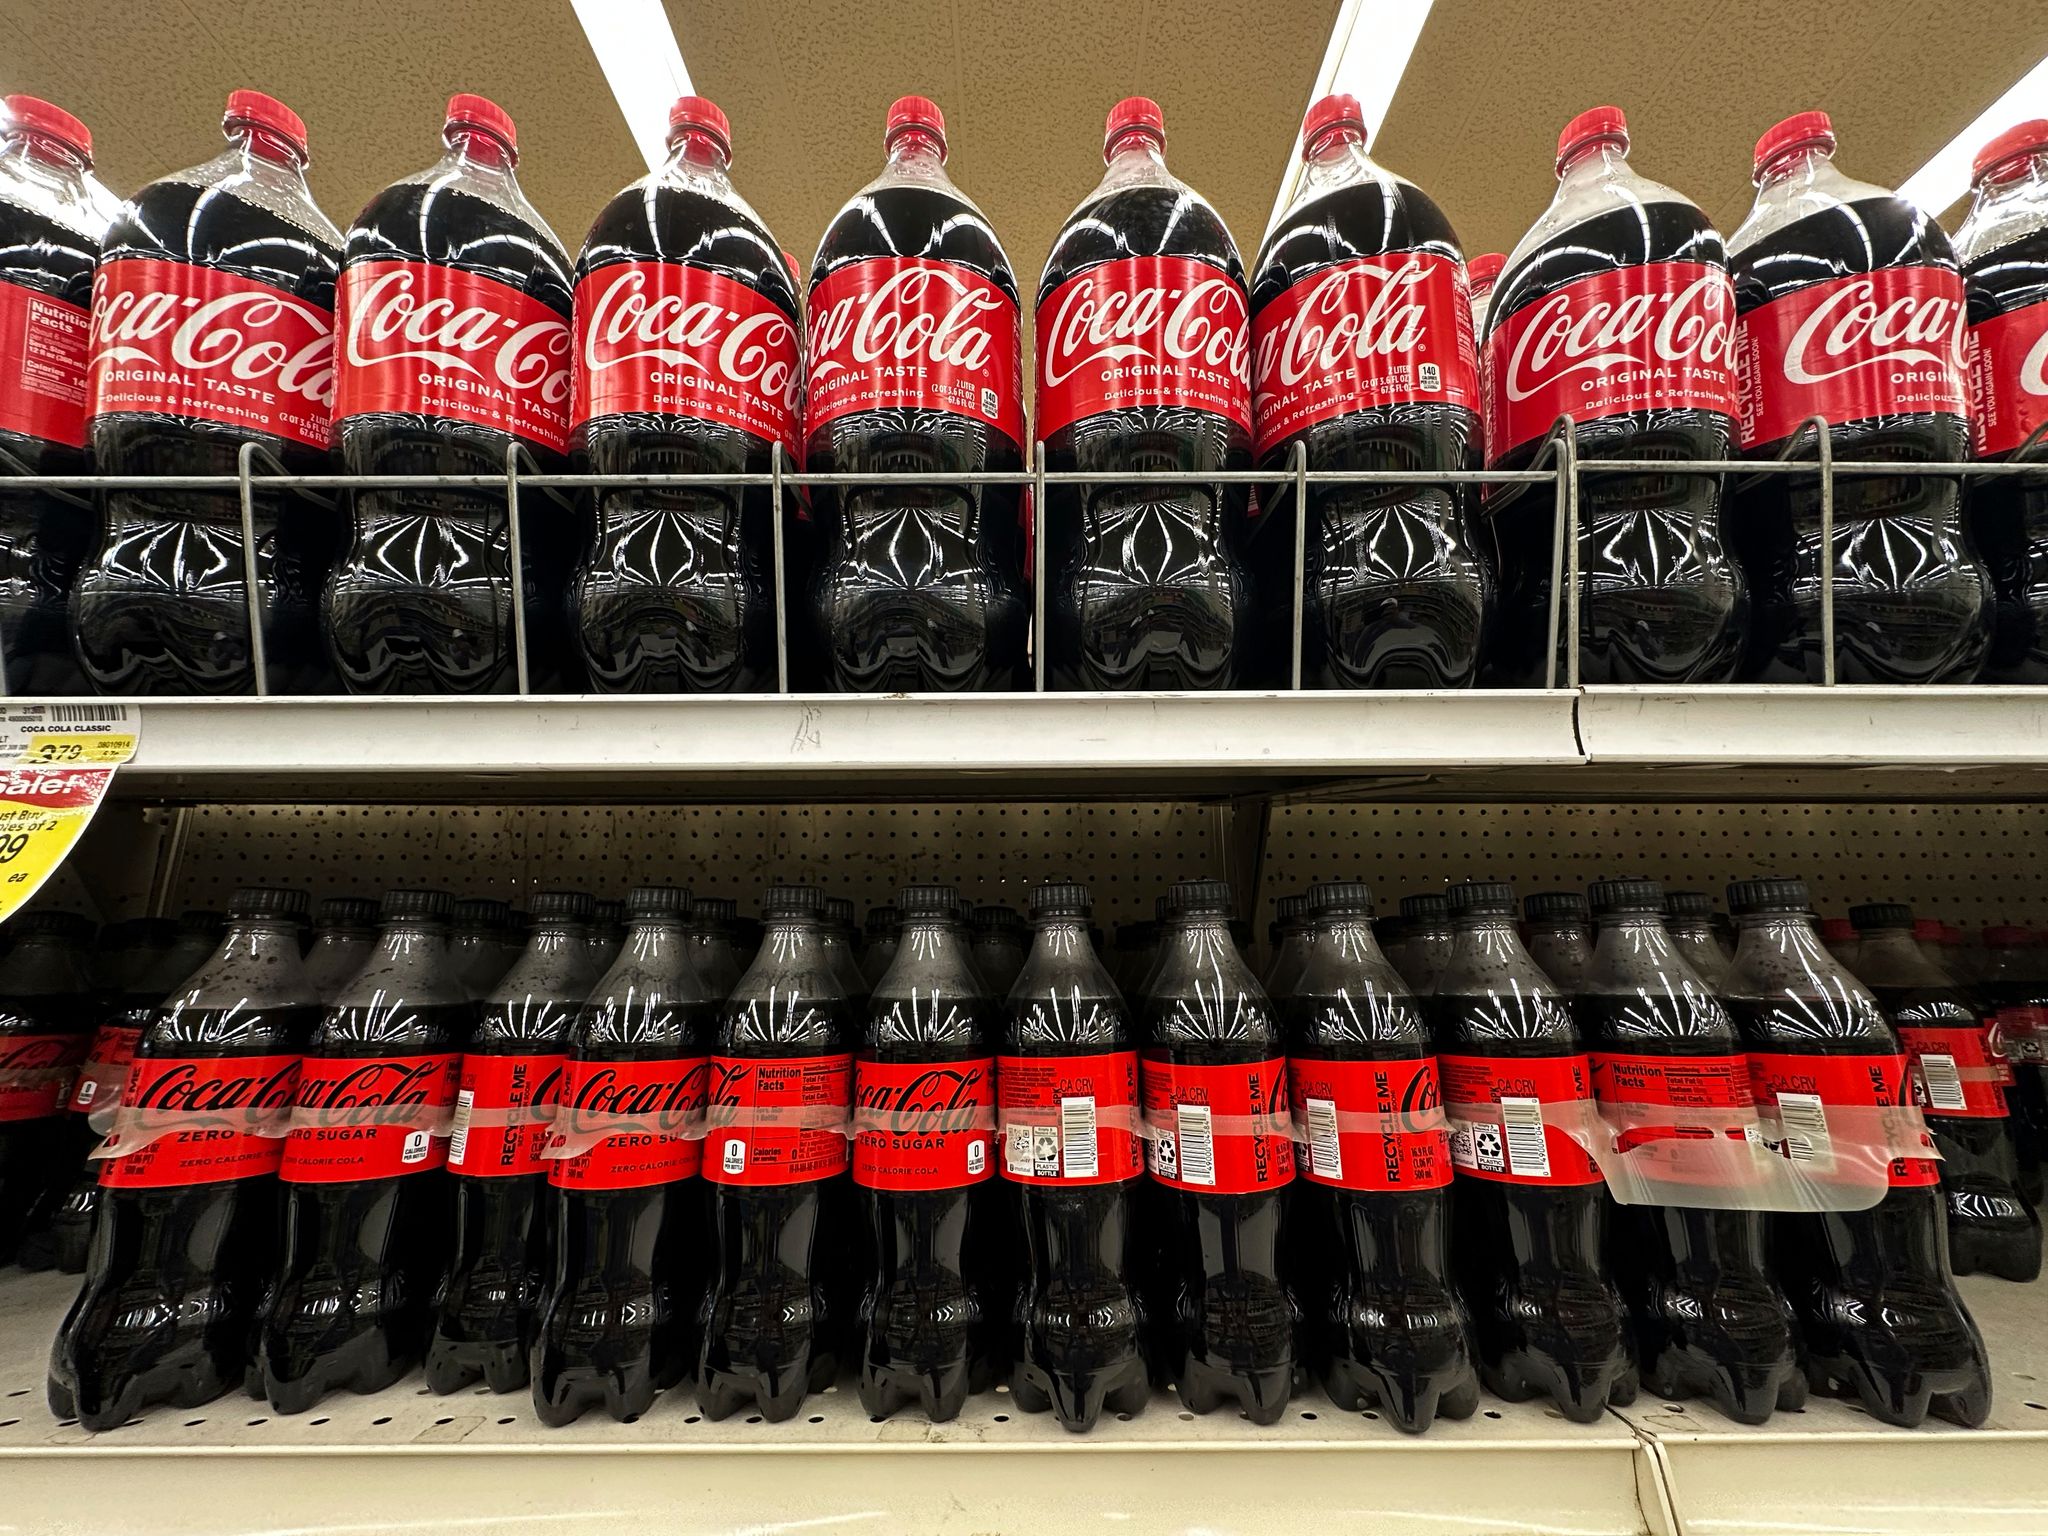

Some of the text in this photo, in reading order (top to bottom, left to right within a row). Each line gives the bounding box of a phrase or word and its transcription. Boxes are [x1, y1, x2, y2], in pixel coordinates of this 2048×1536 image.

[32, 311, 73, 333] Facts
[1253, 260, 1437, 391] a-Cola
[1506, 275, 1738, 401] Coca-Col
[1101, 365, 1230, 389] ORIGINAL TASTE
[1423, 367, 1435, 375] 140
[1581, 367, 1725, 391] ORIGINAL TASTE
[105, 370, 275, 404] ORIGINAL TASTE
[814, 367, 928, 401] ORIGINAL TASTE
[961, 381, 975, 391] LITER
[1303, 367, 1356, 394] TASTE
[1362, 376, 1398, 389] (2 3.6 FL
[1985, 373, 1994, 394] AGAIN
[650, 372, 784, 421] ORIGINAL TASTE
[932, 384, 938, 392] (2
[948, 387, 957, 396] 3.6
[966, 391, 975, 401] OZ)
[985, 391, 996, 403] 140
[1381, 385, 1394, 394] 67.6
[1755, 384, 1763, 401] YOU
[419, 373, 567, 429] ORIGINAL TASTE
[814, 400, 848, 419] Delicious
[861, 388, 923, 399] Refreshing
[948, 396, 960, 405] 67.6
[962, 399, 967, 407] FL
[968, 401, 975, 409] OZ
[1105, 389, 1158, 400] Delicious
[1176, 388, 1228, 408] Refreshing
[1585, 391, 1650, 409] Delicious
[1669, 389, 1726, 404] Refreshing
[1987, 396, 1995, 412] YOU
[105, 394, 269, 423] Delicious & Refreshing
[1284, 392, 1354, 425] & Refreshing
[280, 413, 319, 431] (2 3.6 FL
[311, 413, 329, 426] 2 LITE
[422, 396, 564, 446] Delicious & Refreshing
[654, 395, 711, 410] Delicious
[729, 407, 781, 439] Refreshing
[1988, 412, 1997, 427] SEE
[300, 427, 322, 442] 67.6 FL
[28, 821, 57, 831] of 2
[8, 873, 28, 882] ea
[512, 1063, 527, 1089] ME
[758, 1067, 800, 1079] Nutrition
[1612, 1063, 1662, 1076] Nutrition
[758, 1080, 785, 1090] Facts
[1060, 1079, 1094, 1092] CA CRV
[1248, 1072, 1259, 1100] ME
[1374, 1071, 1391, 1099] ME
[1498, 1079, 1536, 1093] CA CRV
[1572, 1066, 1583, 1091] ME
[1615, 1075, 1645, 1088] Facts
[1772, 1073, 1816, 1089] CA CRV
[1869, 1065, 1887, 1093] ME
[1176, 1087, 1208, 1100] CA CRV
[1314, 1083, 1333, 1096] CRV
[177, 1130, 235, 1143] ZERO
[316, 1128, 377, 1140] SUGAR
[414, 1135, 421, 1146] 0
[607, 1135, 652, 1148] ZERO
[1378, 1102, 1401, 1182] RECYCLE
[732, 1144, 737, 1156] 0
[859, 1137, 945, 1149] ZERO SUGAR
[974, 1145, 979, 1157] 0
[1251, 1104, 1268, 1182] RECYCLE
[792, 1149, 797, 1160] 0
[179, 1159, 210, 1168] ZERO
[610, 1161, 676, 1173] ZERO CALORIE
